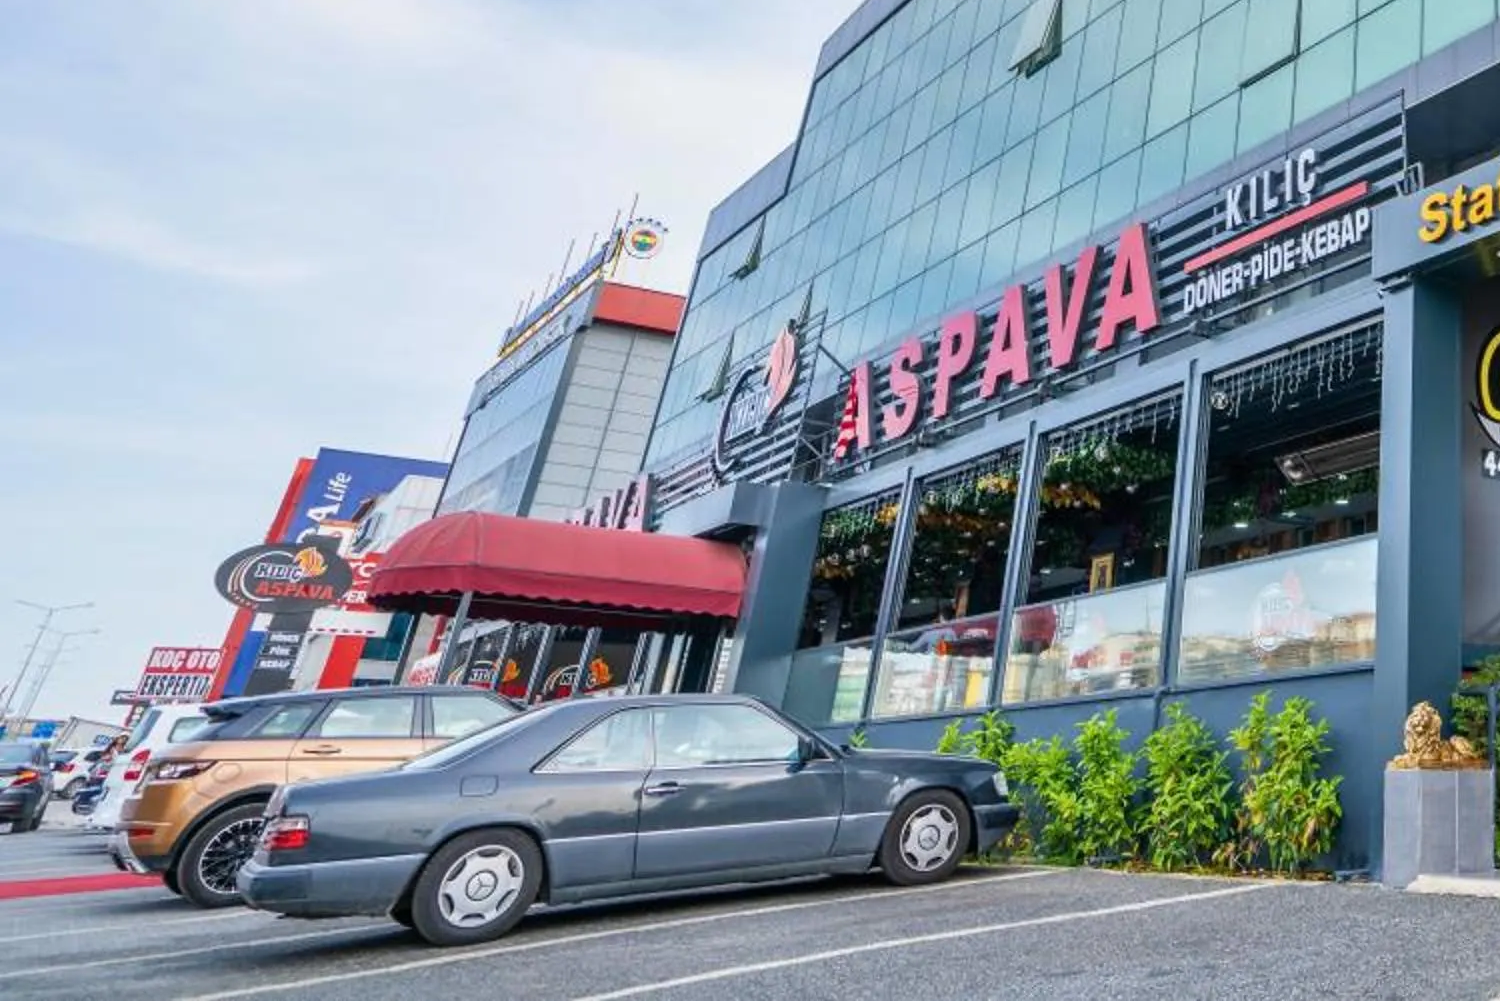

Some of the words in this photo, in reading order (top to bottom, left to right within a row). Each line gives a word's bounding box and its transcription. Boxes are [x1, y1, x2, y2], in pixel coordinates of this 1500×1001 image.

[1224, 147, 1320, 232] KILIÇ
[834, 222, 1162, 463] ASPAVA
[255, 581, 335, 600] ASPAVA
[149, 650, 187, 672] KOÇ
[186, 651, 220, 670] OTO
